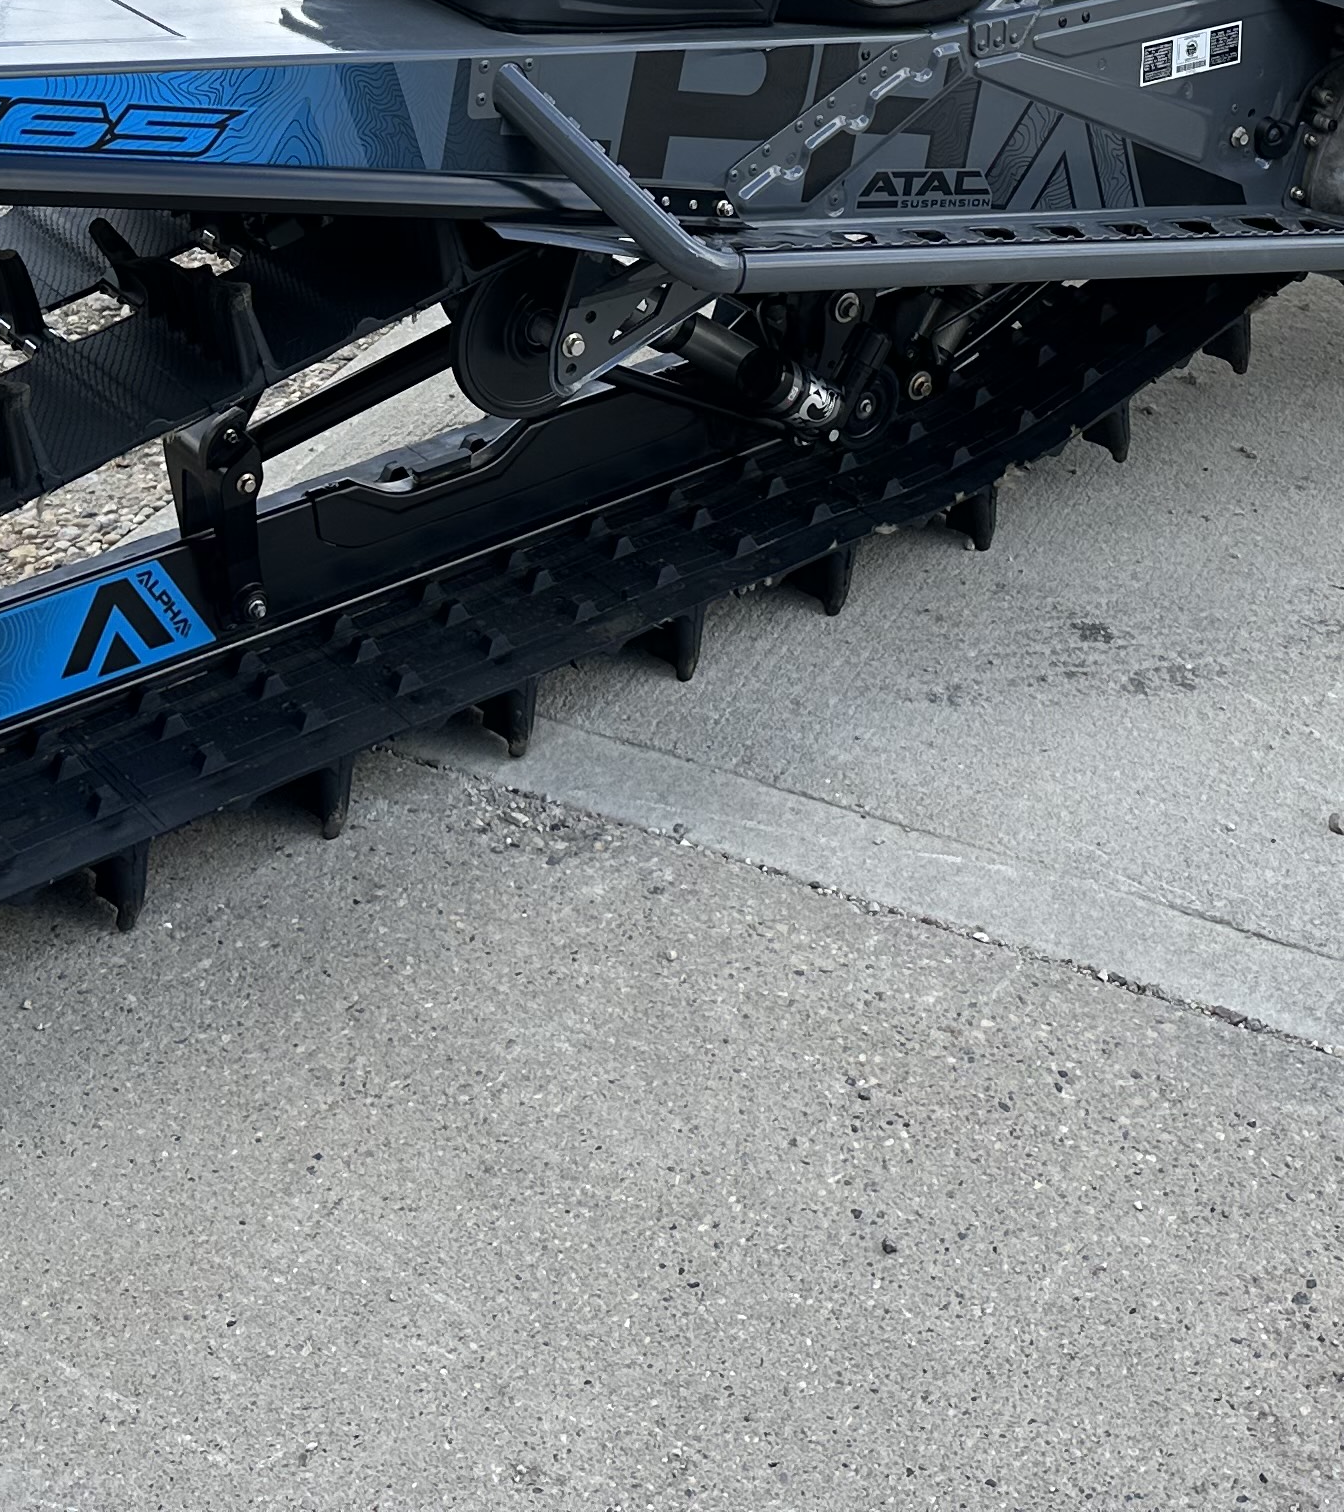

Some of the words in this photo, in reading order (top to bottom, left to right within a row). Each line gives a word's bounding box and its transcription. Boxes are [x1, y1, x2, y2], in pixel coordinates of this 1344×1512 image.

[858, 170, 991, 198] ATAC
[900, 197, 991, 209] SUSPENSION
[135, 569, 193, 639] ALPHA
